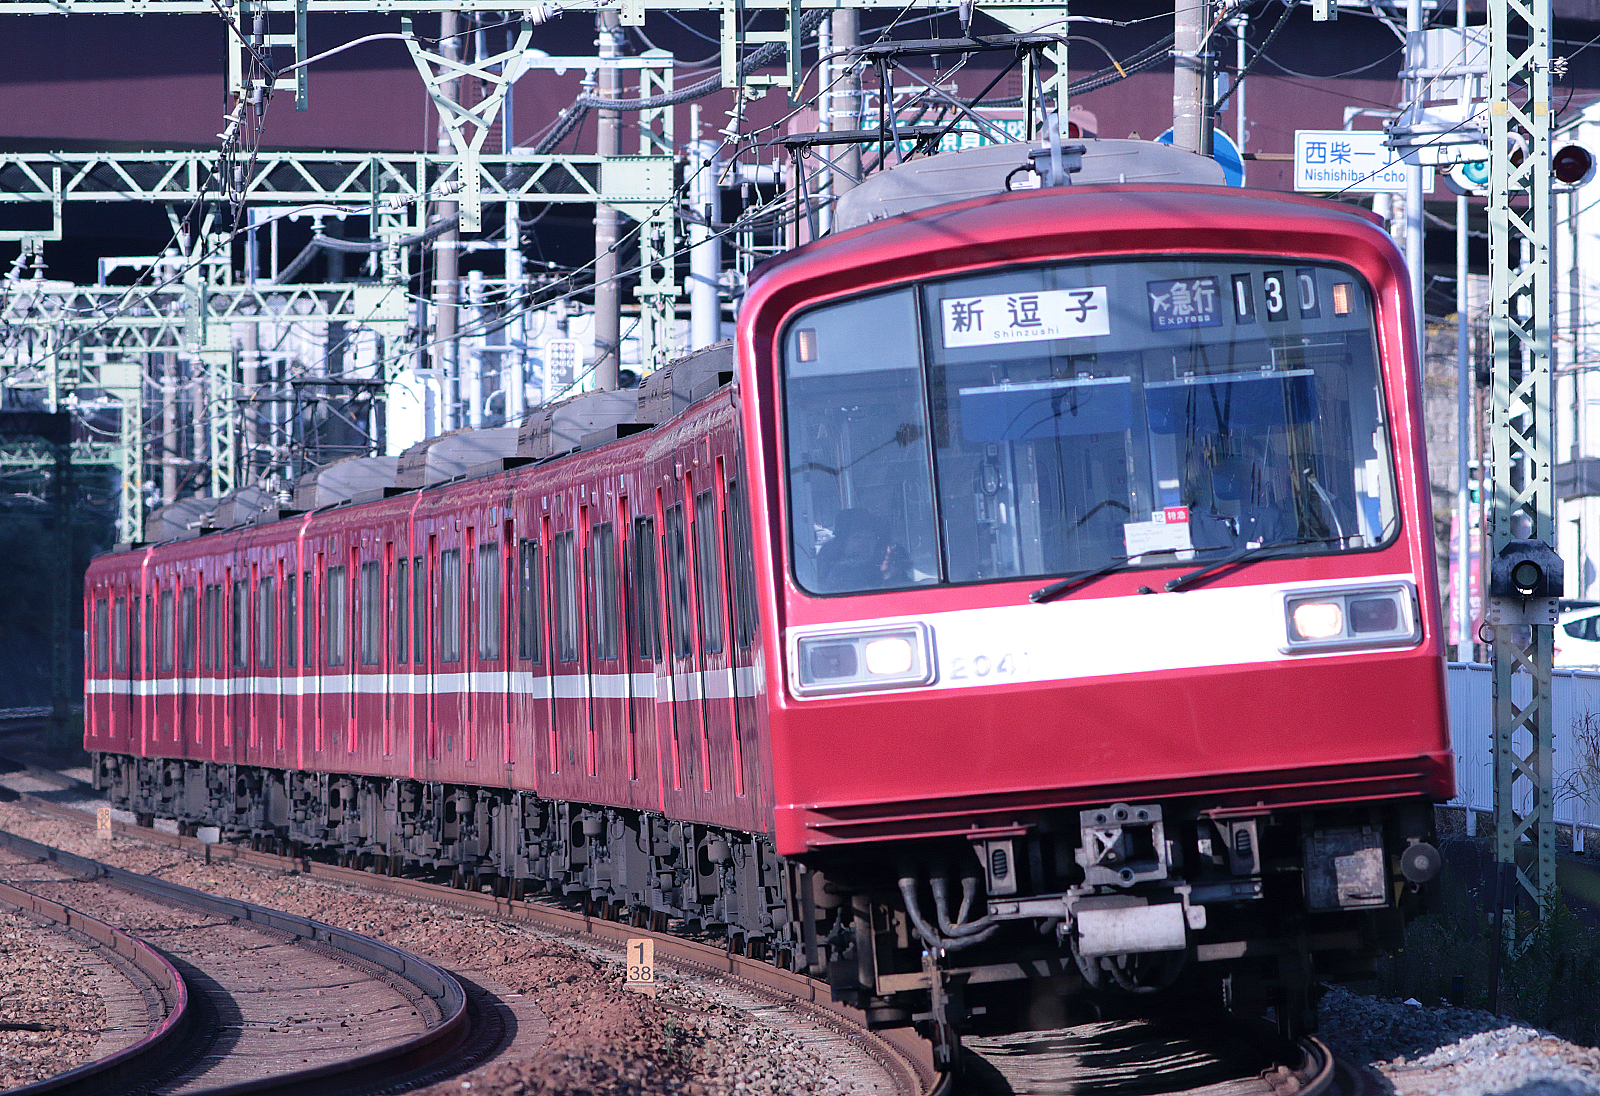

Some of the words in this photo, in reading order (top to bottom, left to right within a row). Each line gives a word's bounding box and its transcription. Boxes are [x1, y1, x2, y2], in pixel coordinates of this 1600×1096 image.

[1305, 141, 1393, 165] 西柴一丁
[1305, 169, 1365, 182] Nishishiba
[1170, 280, 1215, 315] 急行
[951, 291, 1099, 333] 新逗子
[1158, 314, 1211, 325] Express
[993, 326, 1060, 339] Shinzushi
[633, 942, 644, 965] 1
[629, 966, 652, 981] 38
